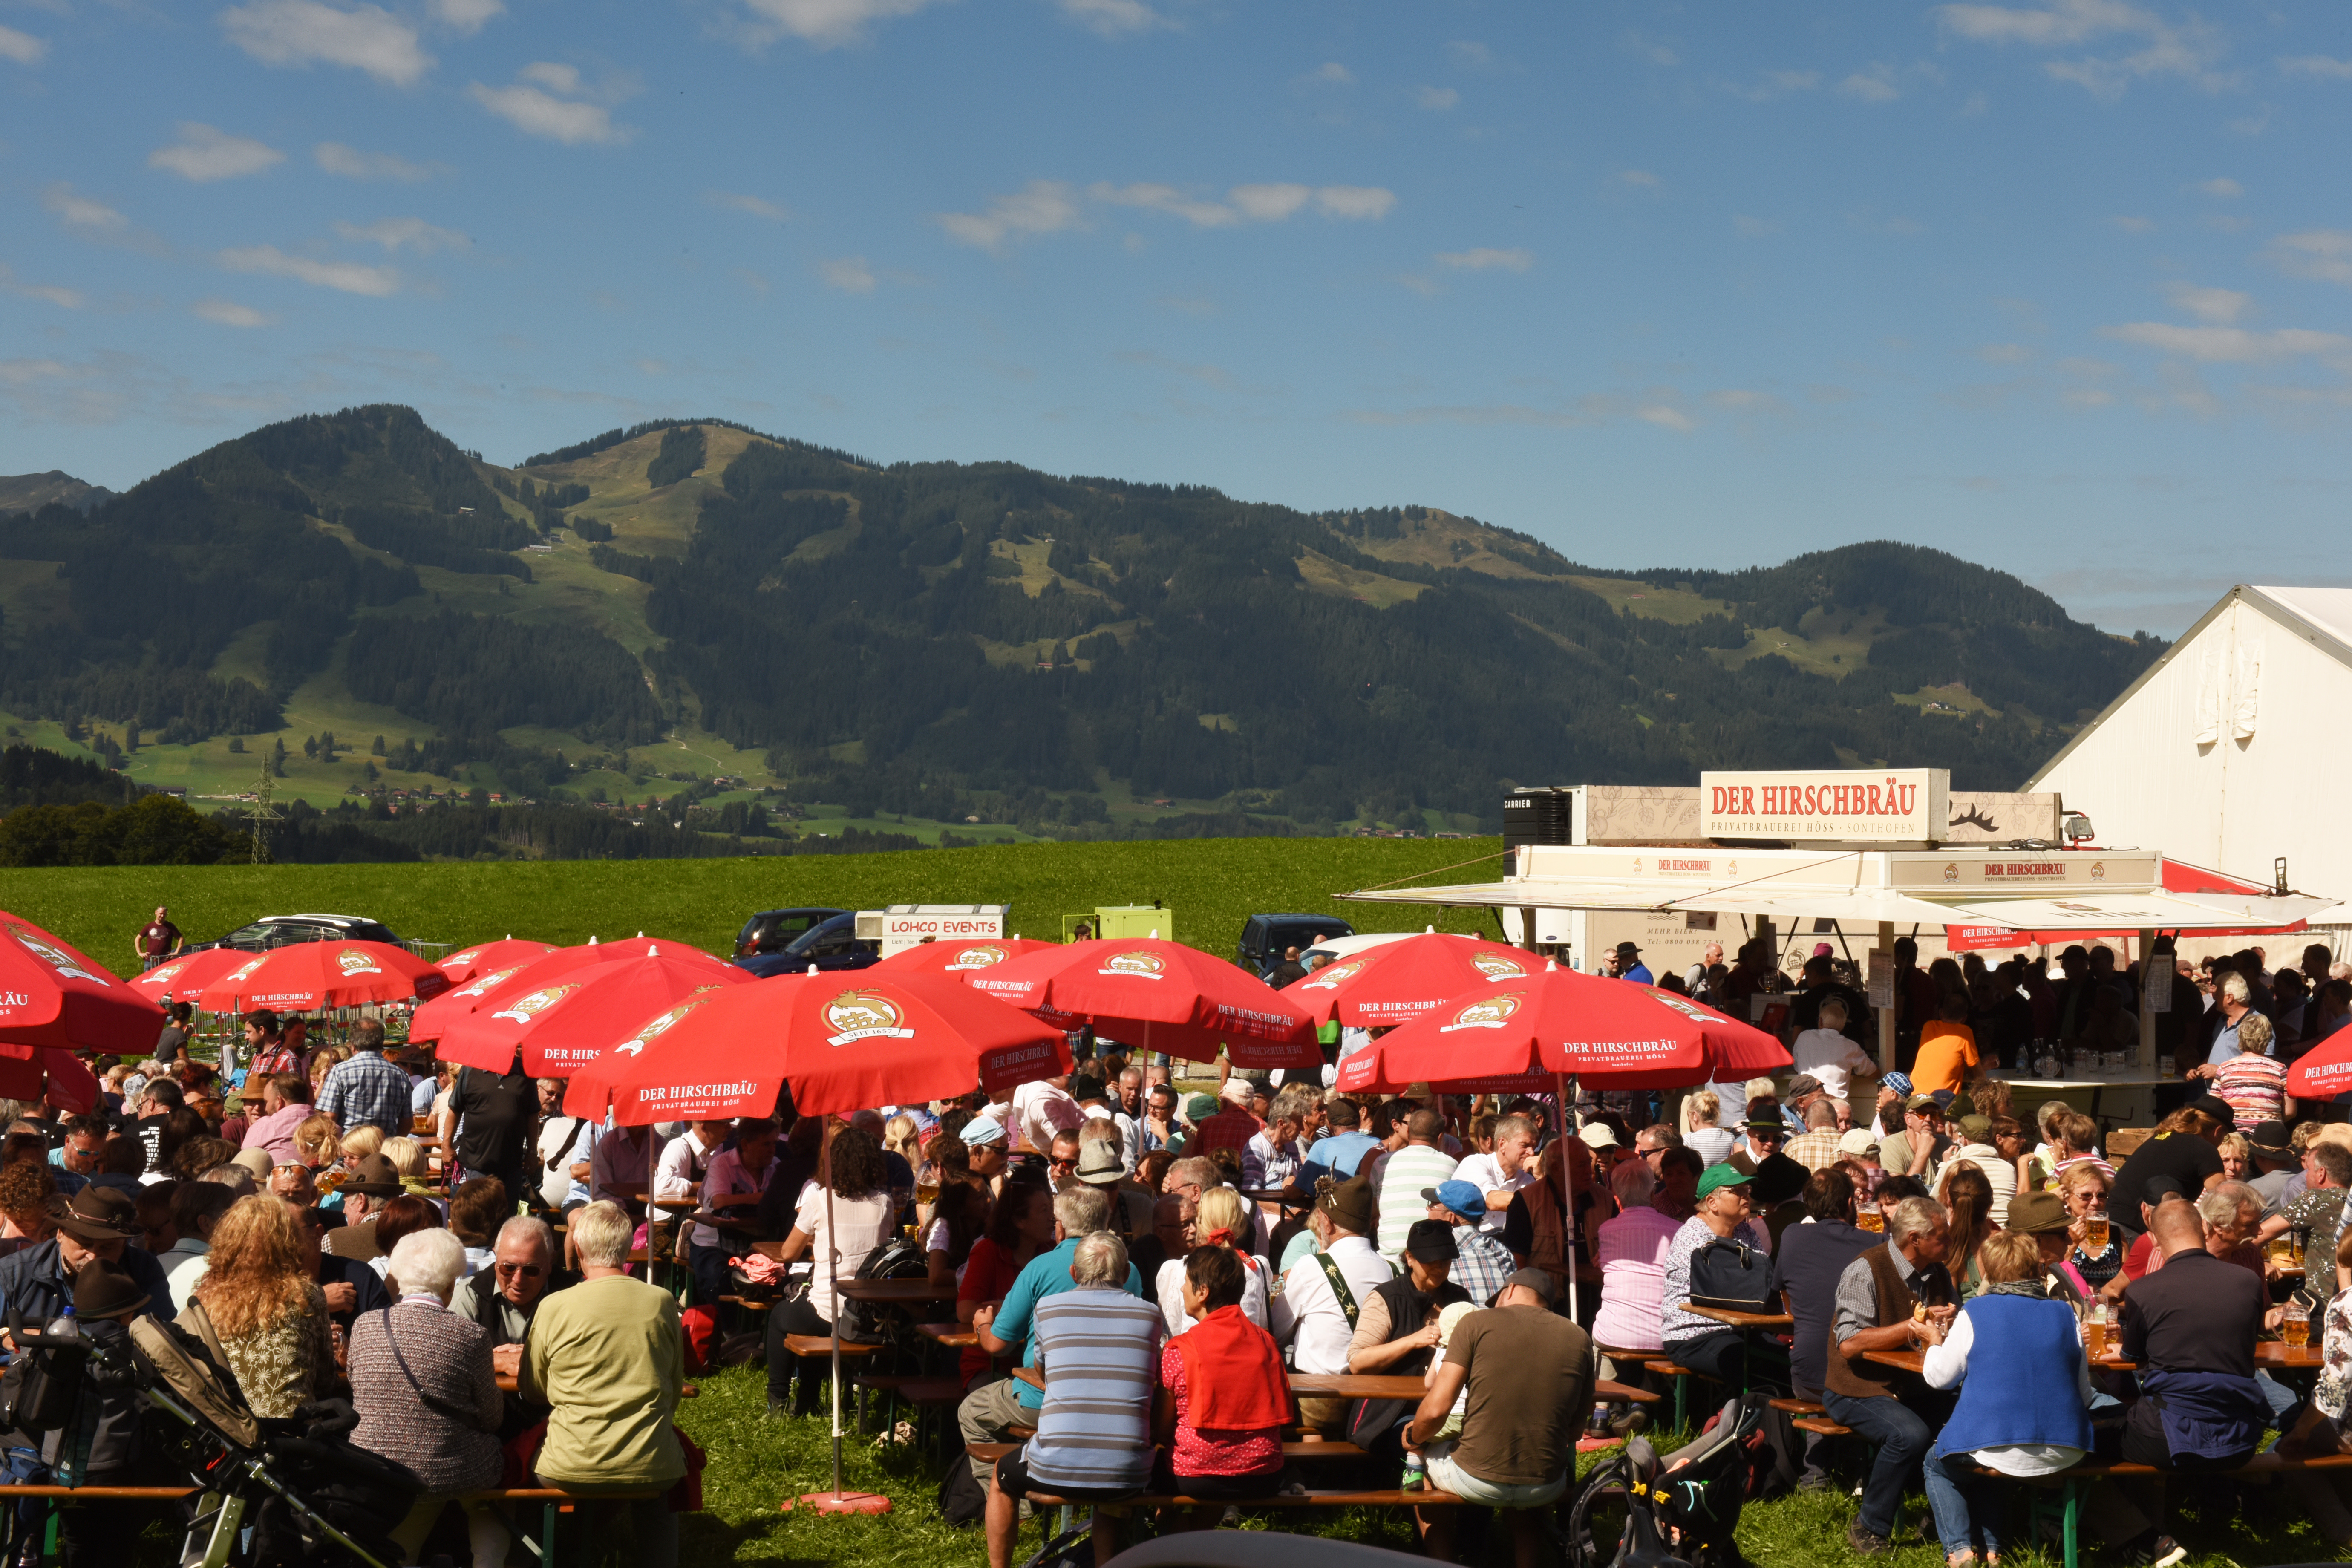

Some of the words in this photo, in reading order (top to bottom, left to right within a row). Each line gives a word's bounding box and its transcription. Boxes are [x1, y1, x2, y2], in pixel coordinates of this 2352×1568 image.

[1712, 786, 1755, 815] DER
[1762, 777, 1917, 816] HIRSCHBRÄU
[1505, 799, 1531, 808] CARRIER
[1711, 821, 1801, 832] PRIVATBRAUEREI
[1807, 821, 1834, 833] HÖSS
[1847, 823, 1914, 833] SONTHOFEN
[1658, 859, 1671, 870] DER
[1672, 859, 1711, 871] HIRSCHBRÄU
[1985, 864, 2004, 876] DER
[2007, 863, 2066, 875] HIRSCHBRÄU
[892, 921, 937, 932] LOHCO
[943, 921, 997, 933] EVENTS
[1963, 929, 1975, 937] DER
[973, 980, 987, 989] DER
[988, 981, 1034, 991] HIRSCHBRÄU
[268, 992, 313, 1001] HIRSCHBRÄU
[1359, 1003, 1380, 1012] DER
[1382, 999, 1449, 1011] HIRSCHBRÄ
[1218, 1004, 1235, 1016] DER
[1238, 1008, 1294, 1026] HIRSCHBRÄU
[848, 1030, 869, 1038] SEIT
[1563, 1043, 1590, 1053] DER
[1592, 1039, 1677, 1053] HIRSCHBRÄU
[544, 1049, 568, 1059] DER
[992, 1055, 1005, 1070] DER
[1007, 1043, 1051, 1065] HIRSCHBRÄU
[2304, 1066, 2320, 1078] DER
[640, 1087, 666, 1101] DER
[670, 1080, 757, 1099] HIRSCHBRÄU
[652, 1100, 720, 1110] PRIVATBRAUEREI
